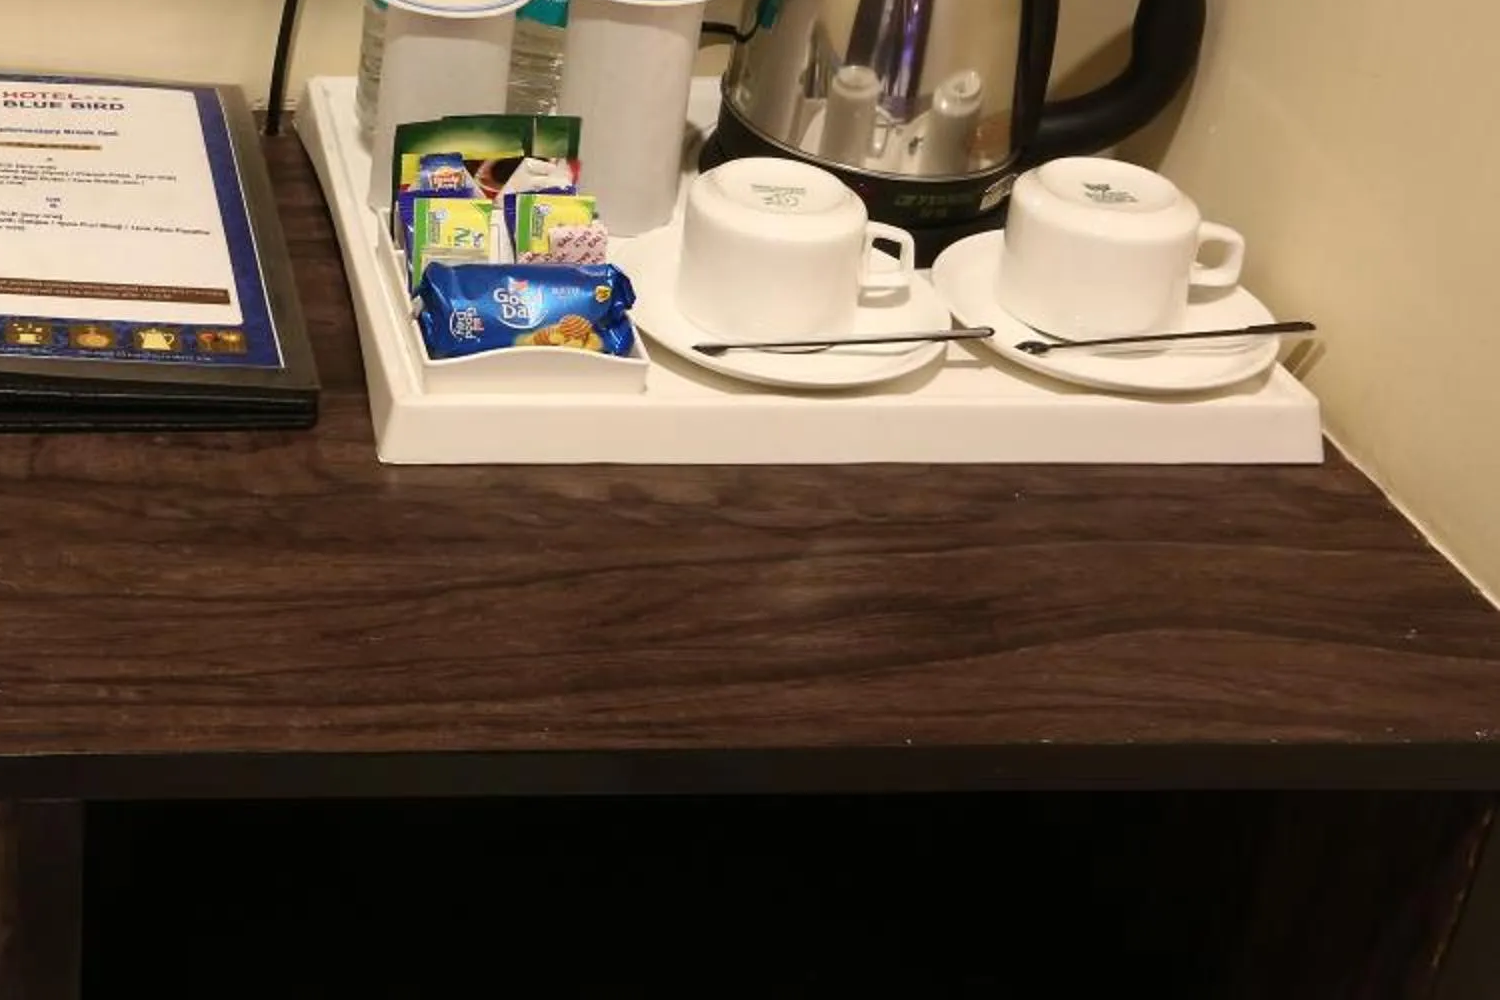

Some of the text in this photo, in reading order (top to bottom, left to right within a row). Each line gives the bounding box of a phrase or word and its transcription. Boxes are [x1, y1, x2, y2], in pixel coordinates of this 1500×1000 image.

[2, 91, 81, 101] HOTEL
[3, 101, 126, 111] BLUE BIRD
